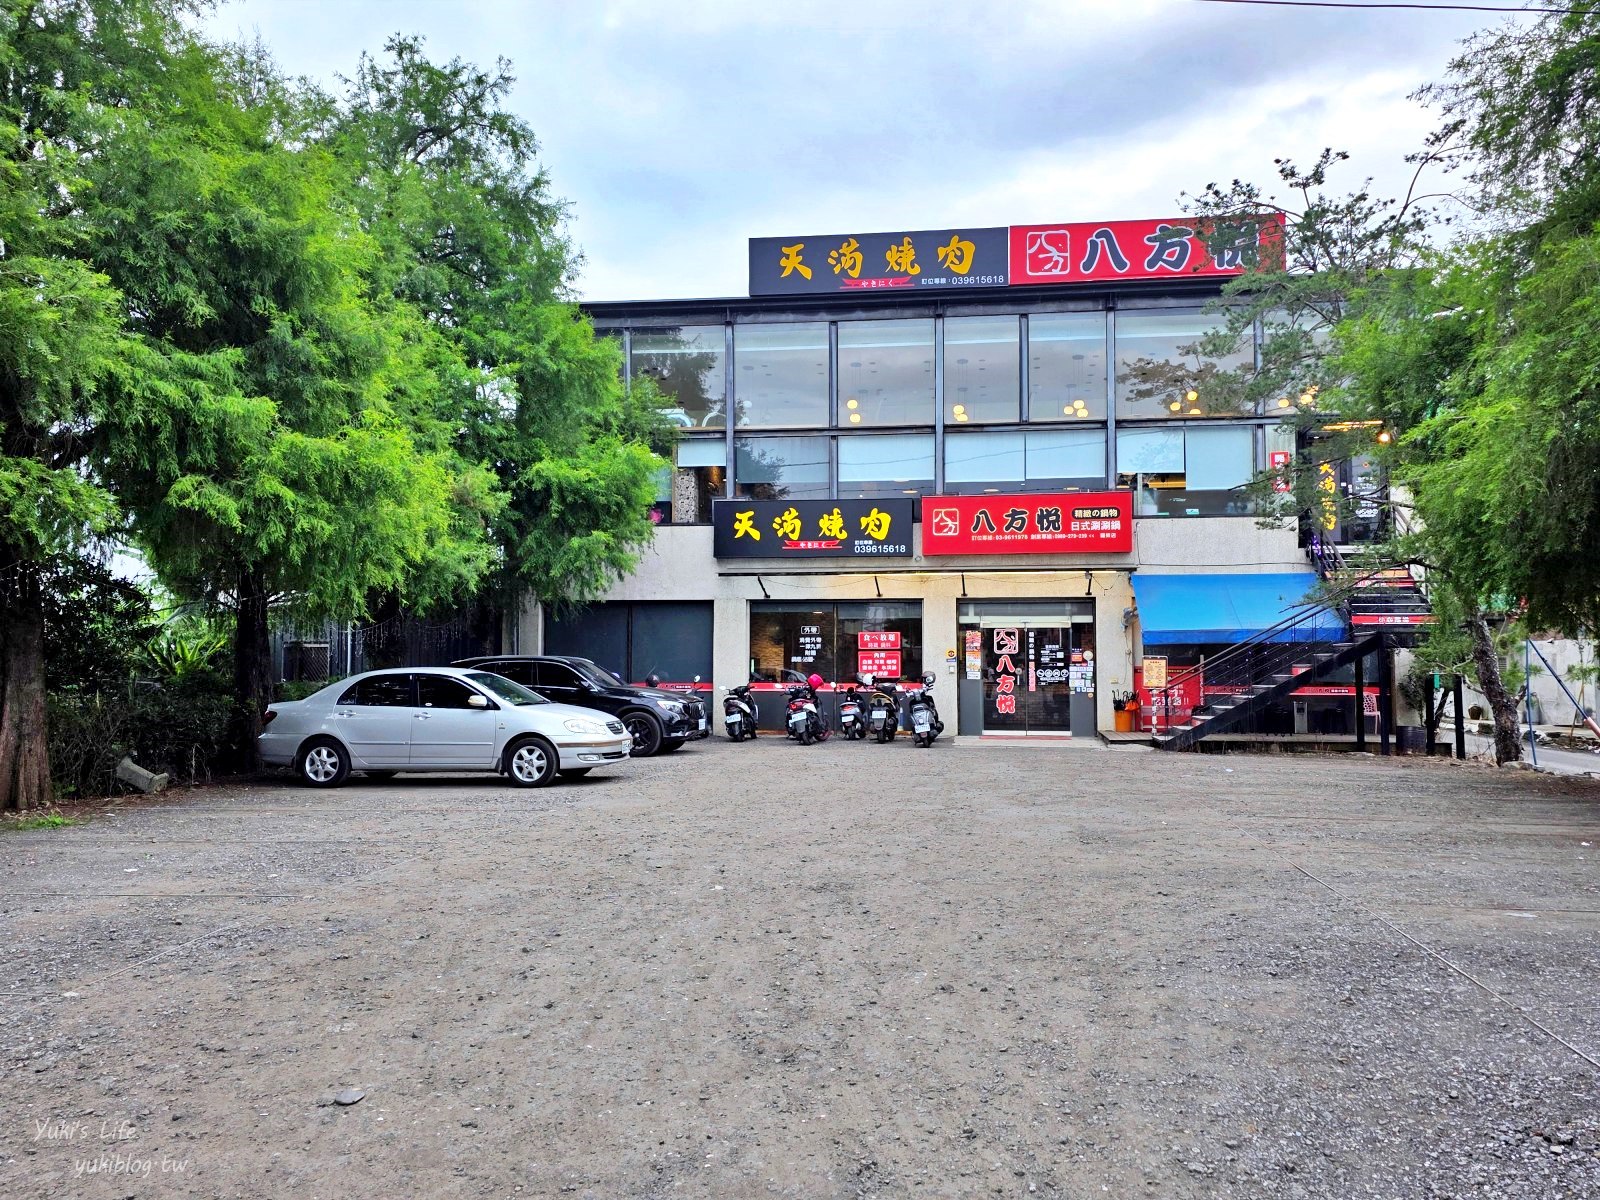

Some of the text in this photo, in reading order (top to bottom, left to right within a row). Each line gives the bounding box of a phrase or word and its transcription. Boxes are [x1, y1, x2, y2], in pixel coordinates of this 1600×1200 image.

[861, 279, 894, 288] やきにく
[854, 544, 906, 553] 039615618
[996, 654, 1015, 714] 八方悅
